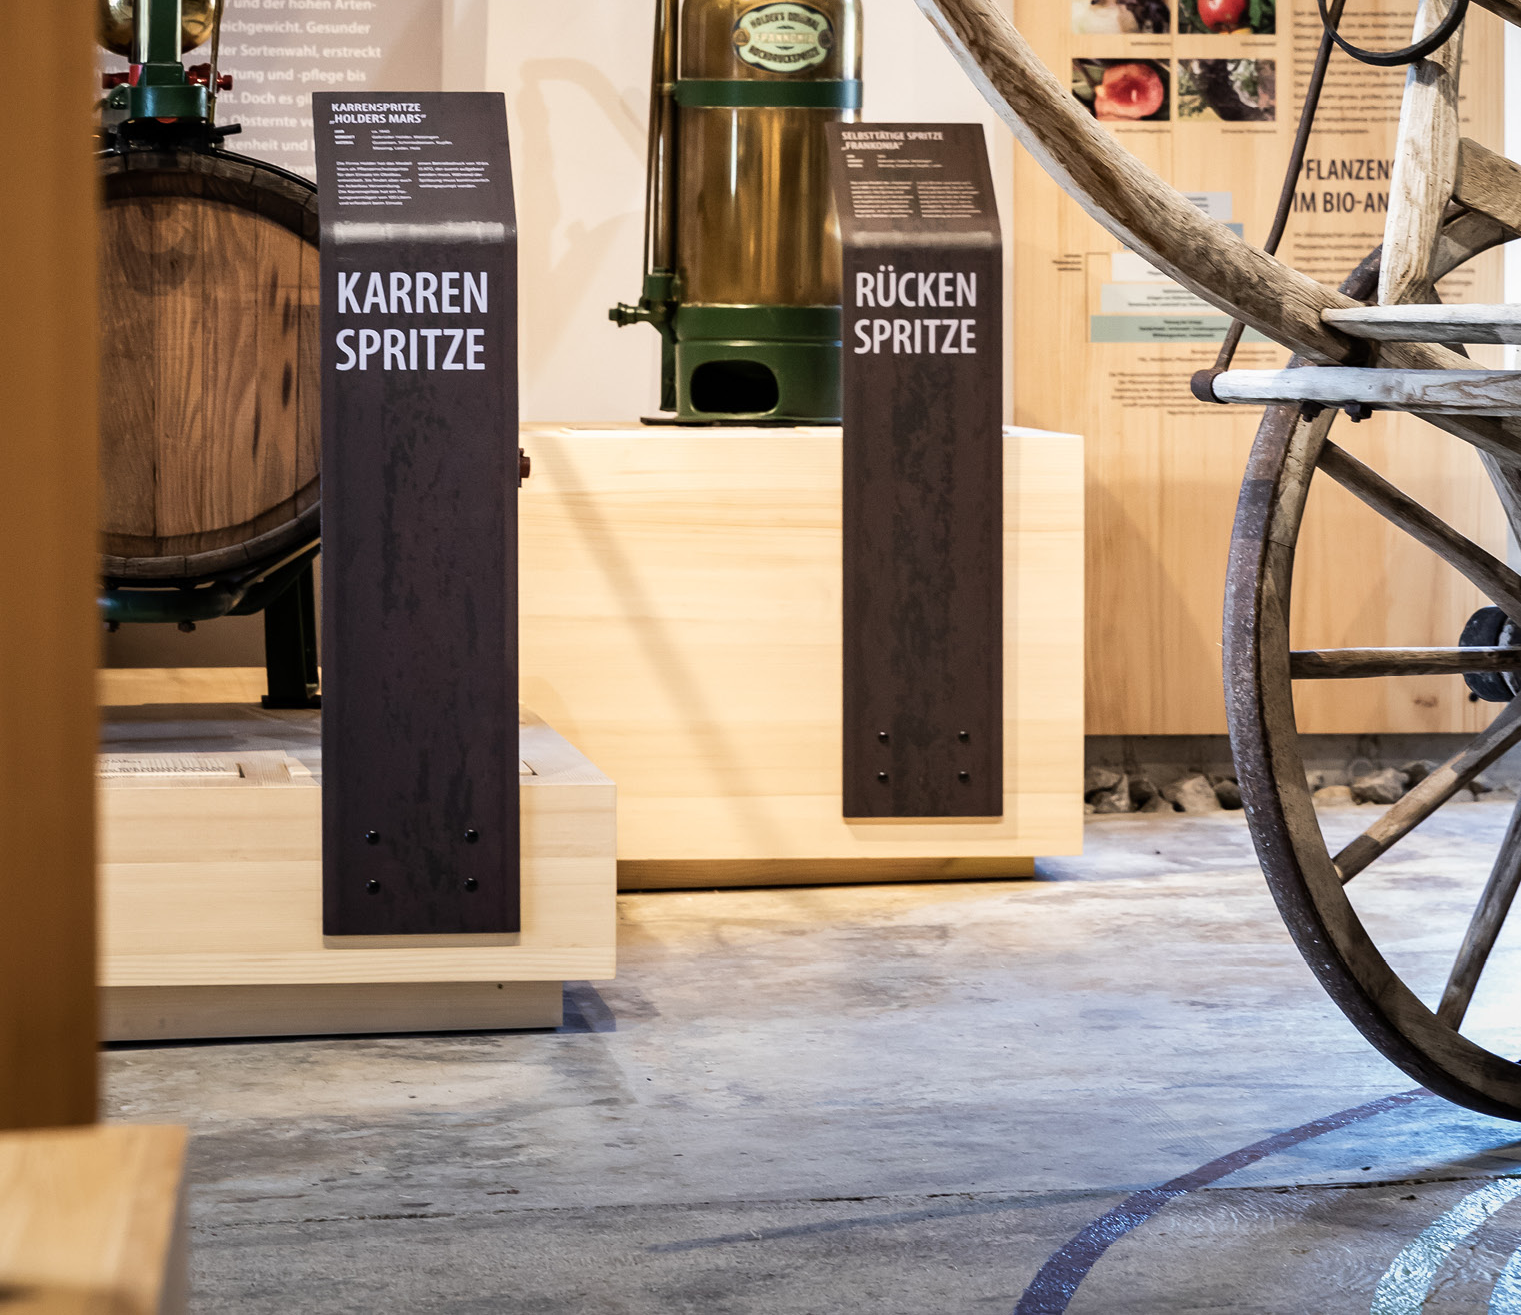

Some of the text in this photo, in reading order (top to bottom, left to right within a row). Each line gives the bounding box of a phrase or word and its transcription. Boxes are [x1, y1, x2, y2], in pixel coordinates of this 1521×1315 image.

[306, 22, 371, 34] Gesunder
[240, 44, 319, 59] Sortenwahl,
[323, 46, 381, 59] erstreckt
[268, 68, 293, 81] und
[297, 69, 343, 83] -pflege
[347, 70, 367, 82] bis
[241, 92, 276, 104] Doch
[278, 94, 293, 104] es
[331, 103, 422, 112] KARRENSPRITZE
[231, 114, 298, 127] Obsternte
[329, 114, 427, 124] „HOLDERS MARS“
[841, 130, 944, 141] SELBSTTÄTIGE SPRITZE
[281, 139, 307, 151] und
[1293, 192, 1389, 213] IM BIO-AN
[338, 271, 488, 314] KARREN
[856, 264, 977, 308] RÜCKEN
[854, 318, 977, 354] SPRITZE
[335, 328, 486, 371] SPRITZE
